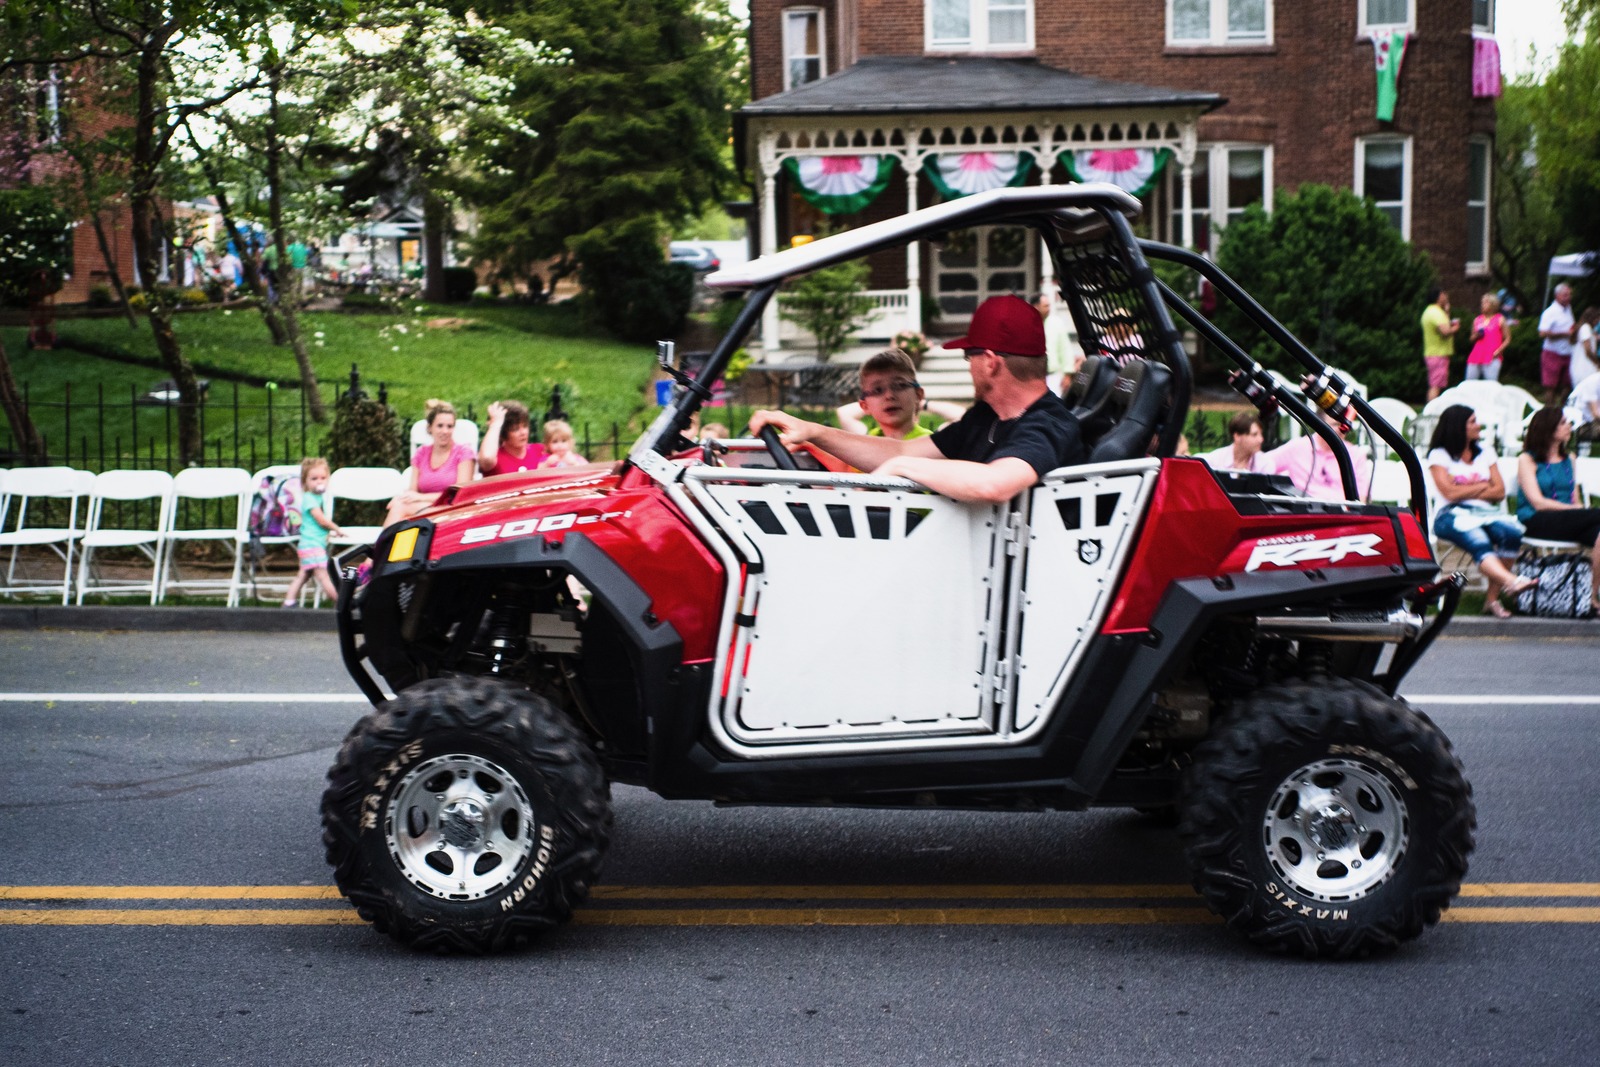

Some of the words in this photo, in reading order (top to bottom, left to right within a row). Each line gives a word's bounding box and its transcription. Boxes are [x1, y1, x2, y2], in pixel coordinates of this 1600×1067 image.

[460, 513, 578, 545] 800
[1244, 533, 1384, 573] RZR
[359, 738, 425, 836] MAXXIS
[499, 823, 554, 913] BIGHORN
[1265, 881, 1350, 921] MAXXIS
